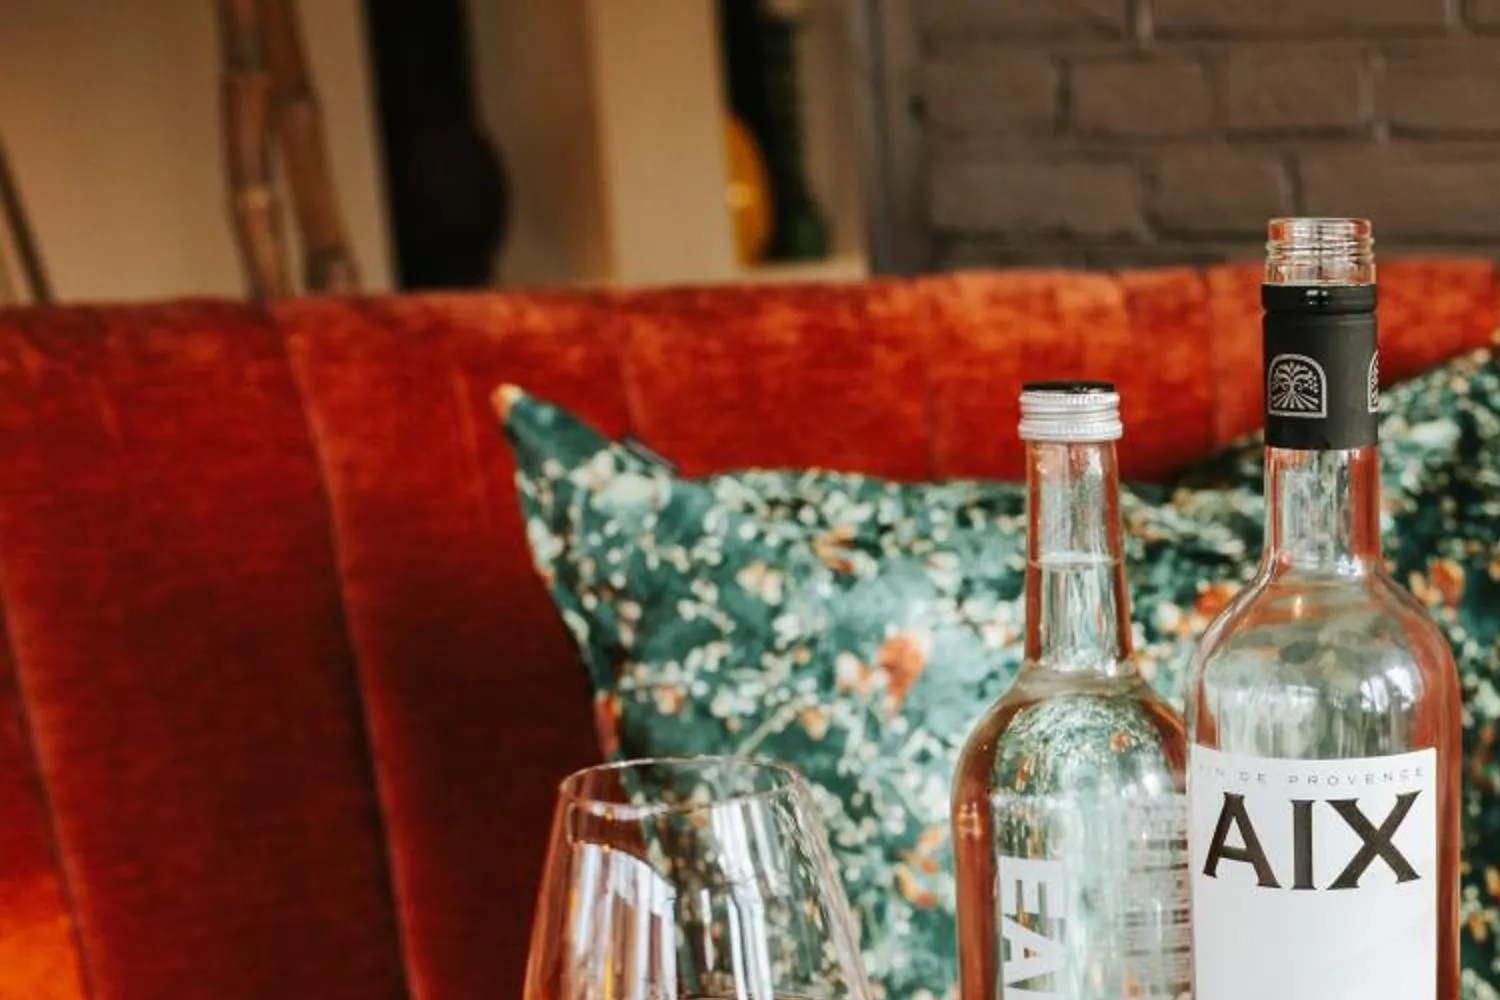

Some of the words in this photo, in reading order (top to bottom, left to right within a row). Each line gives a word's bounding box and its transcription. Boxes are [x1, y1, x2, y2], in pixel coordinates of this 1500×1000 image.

[1240, 770, 1268, 784] DE
[1288, 766, 1424, 787] PROVENCE
[1203, 789, 1423, 891] AIX
